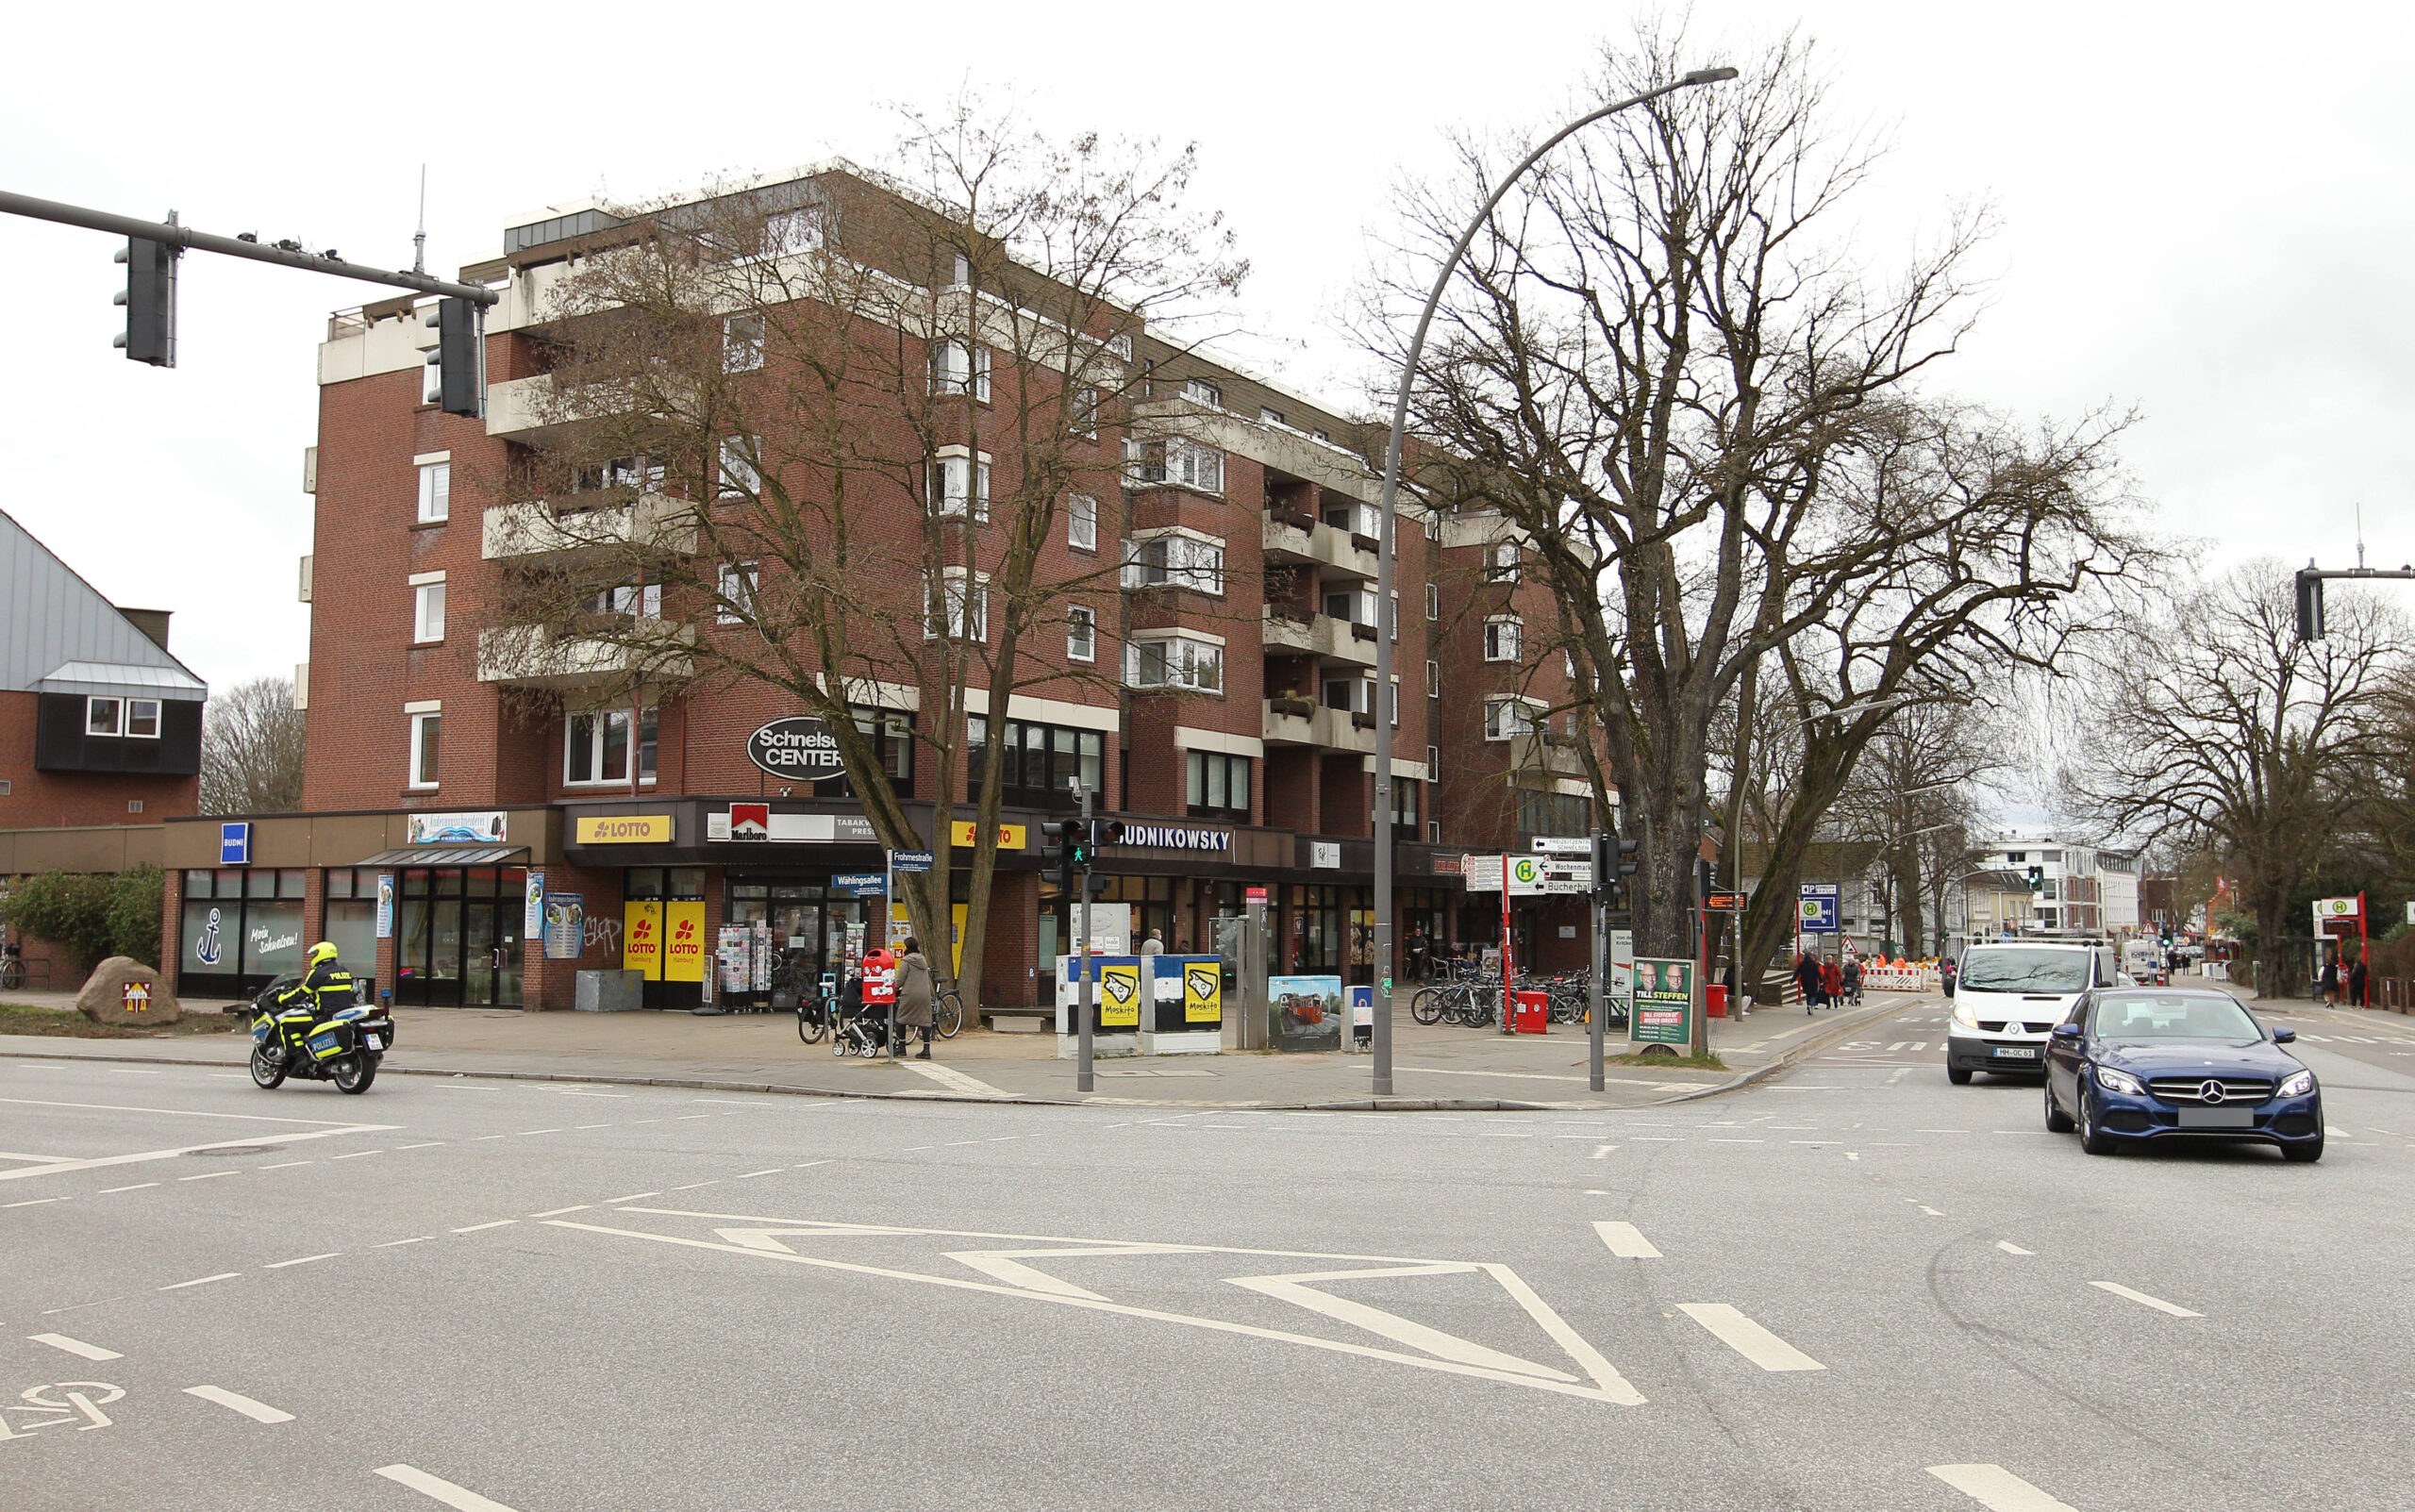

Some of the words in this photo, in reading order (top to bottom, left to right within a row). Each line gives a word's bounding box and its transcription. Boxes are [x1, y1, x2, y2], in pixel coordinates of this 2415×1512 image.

[765, 748, 844, 766] CENTER
[610, 822, 651, 838] LOTTO
[730, 827, 767, 841] Marlboro
[224, 838, 244, 847] BUDNI
[1120, 824, 1230, 851] UDNIKOWSKY
[893, 852, 933, 862] Frohmestraße
[837, 875, 883, 887] Wählingsallee
[250, 924, 269, 942] Moin
[258, 931, 298, 955] Schnelsen!
[627, 943, 657, 954] LOTTO
[669, 943, 699, 955] LOTTO
[631, 955, 652, 964] Hamburg
[673, 956, 694, 965] Hamburg
[1654, 991, 1689, 1000] STEFFEN
[1105, 1005, 1135, 1017] Moskito
[1190, 1002, 1218, 1012] Moskito
[312, 1038, 335, 1053] POLIZEI
